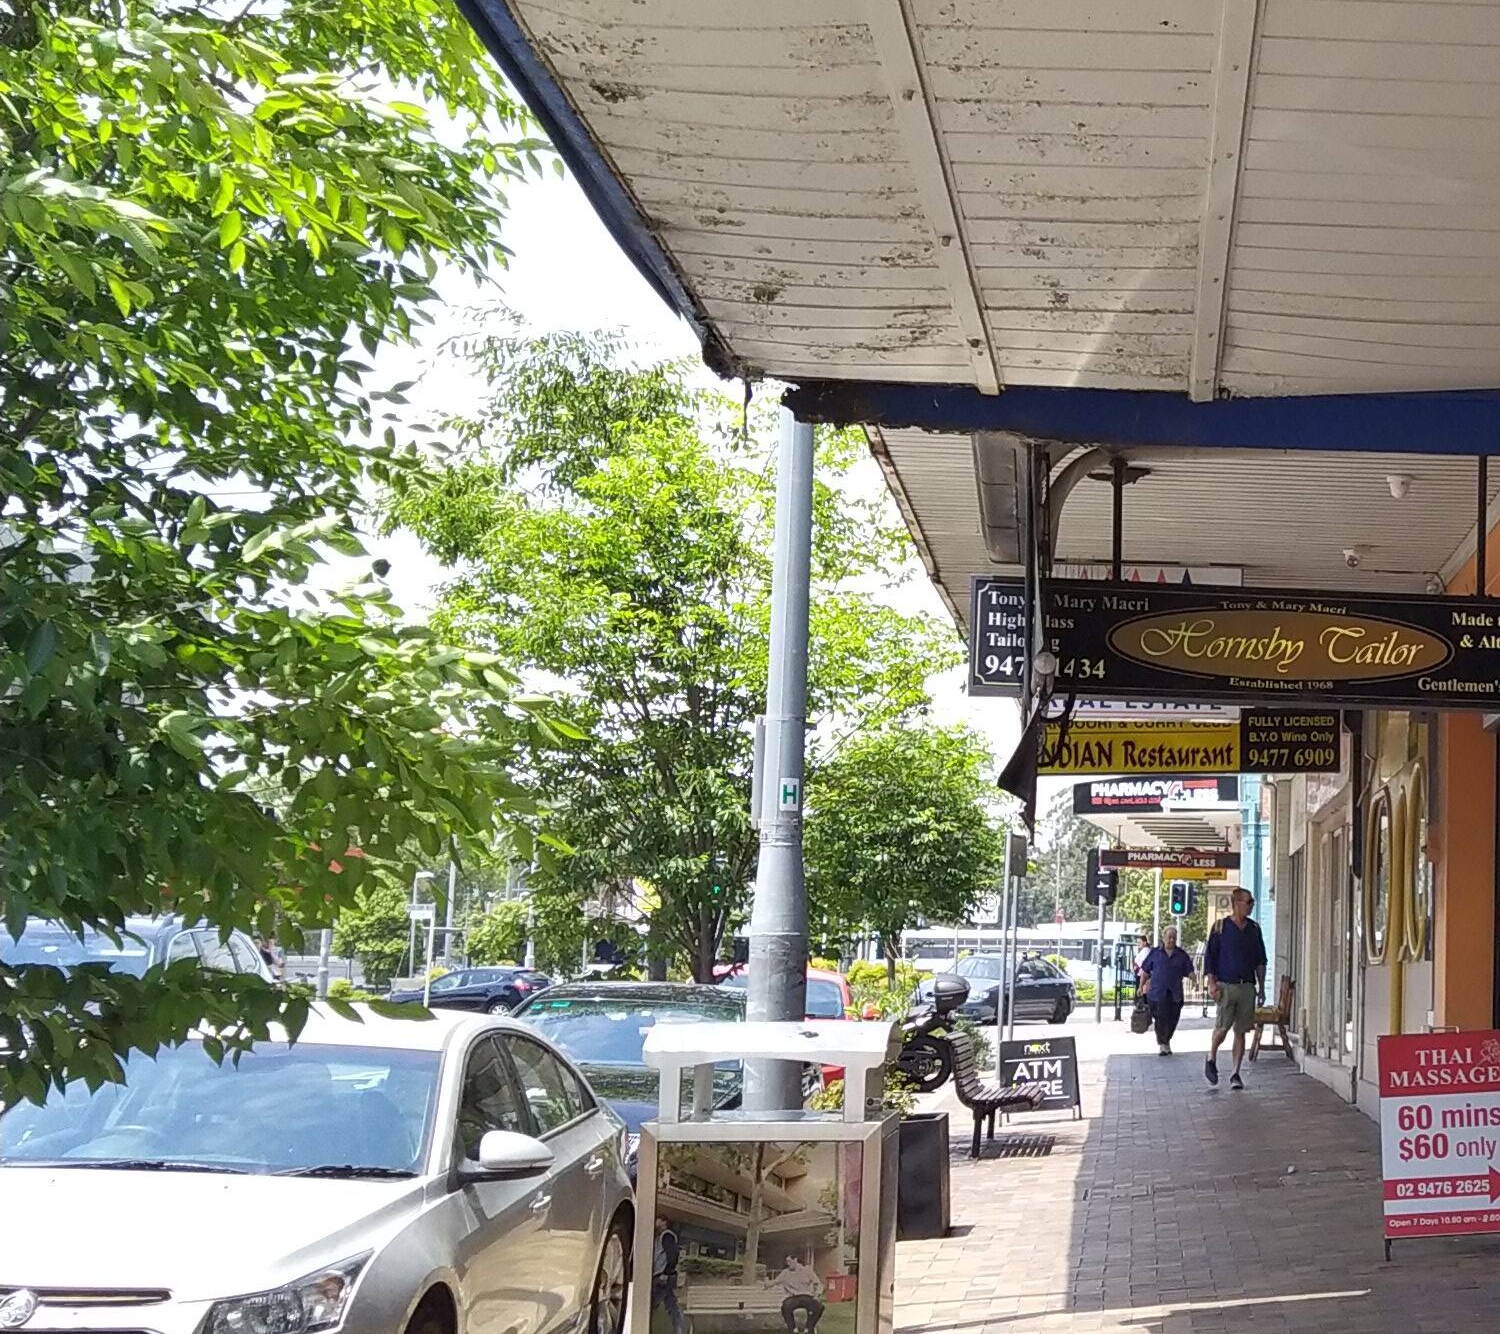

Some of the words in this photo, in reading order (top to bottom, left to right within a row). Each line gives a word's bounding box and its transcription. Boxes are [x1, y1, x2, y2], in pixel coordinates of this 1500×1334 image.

[988, 590, 1026, 609] Tony
[1054, 593, 1096, 612] Mary
[1102, 595, 1150, 611] Macri
[1220, 600, 1251, 611] Tony
[1257, 600, 1267, 609] &
[1272, 601, 1304, 613] Mary
[1309, 603, 1347, 615] Macri
[988, 611, 1026, 629] High
[1031, 614, 1075, 629] lass
[1451, 611, 1494, 627] Made
[1140, 619, 1304, 673] Hornsby
[1319, 626, 1424, 666] Tailor
[1459, 634, 1474, 649] &
[985, 654, 1040, 677] 947
[1229, 676, 1303, 690] Established
[1308, 679, 1335, 690] 1968
[1248, 716, 1281, 727] FULLY
[1283, 715, 1335, 727] LICENSED
[1281, 731, 1307, 742] Wine
[1310, 731, 1335, 744] Only
[1122, 740, 1234, 768] Restaurant
[1248, 748, 1290, 767] 9477
[1294, 748, 1335, 767] 6909
[782, 784, 797, 805] H
[1091, 780, 1172, 797] PHARMACY
[1127, 852, 1183, 862] PHARMACY
[1193, 858, 1216, 868] LESS
[1414, 1047, 1473, 1067] THAI
[1012, 1059, 1062, 1081] ATM
[1398, 1104, 1433, 1131] 60
[1398, 1132, 1449, 1163] $60
[1455, 1136, 1497, 1160] only
[1396, 1182, 1415, 1197] 02
[1418, 1180, 1453, 1196] 9476
[1455, 1179, 1491, 1195] 2625
[1389, 1218, 1412, 1228] Open
[1420, 1217, 1440, 1227] Days
